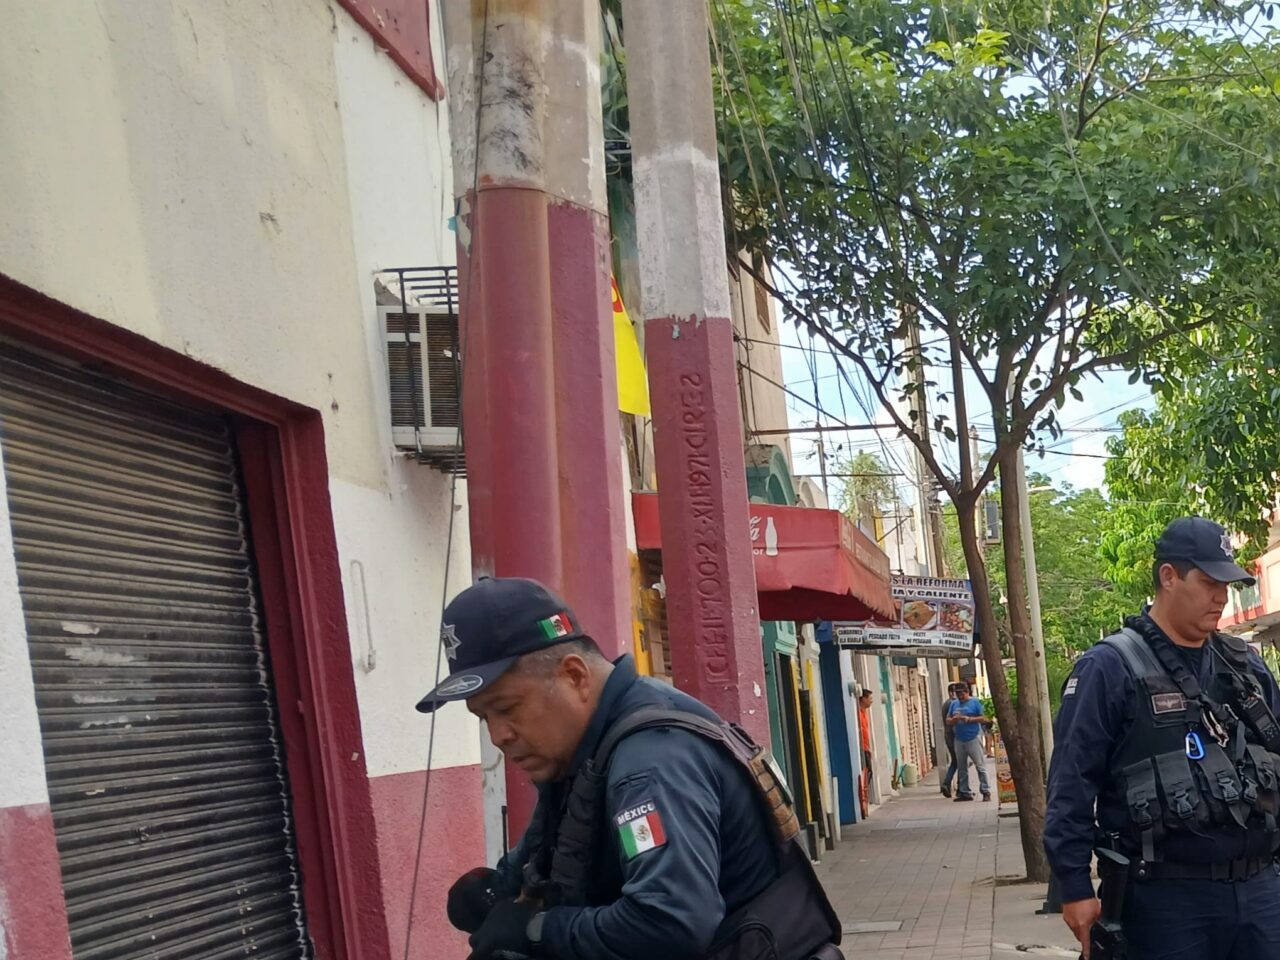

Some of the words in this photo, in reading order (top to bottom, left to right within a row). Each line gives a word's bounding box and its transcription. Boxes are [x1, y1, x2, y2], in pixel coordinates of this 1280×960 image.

[902, 578, 913, 586] LA
[917, 578, 965, 589] REFORMA
[917, 590, 971, 600] CALIENTE
[617, 803, 656, 825] MÉXICO
